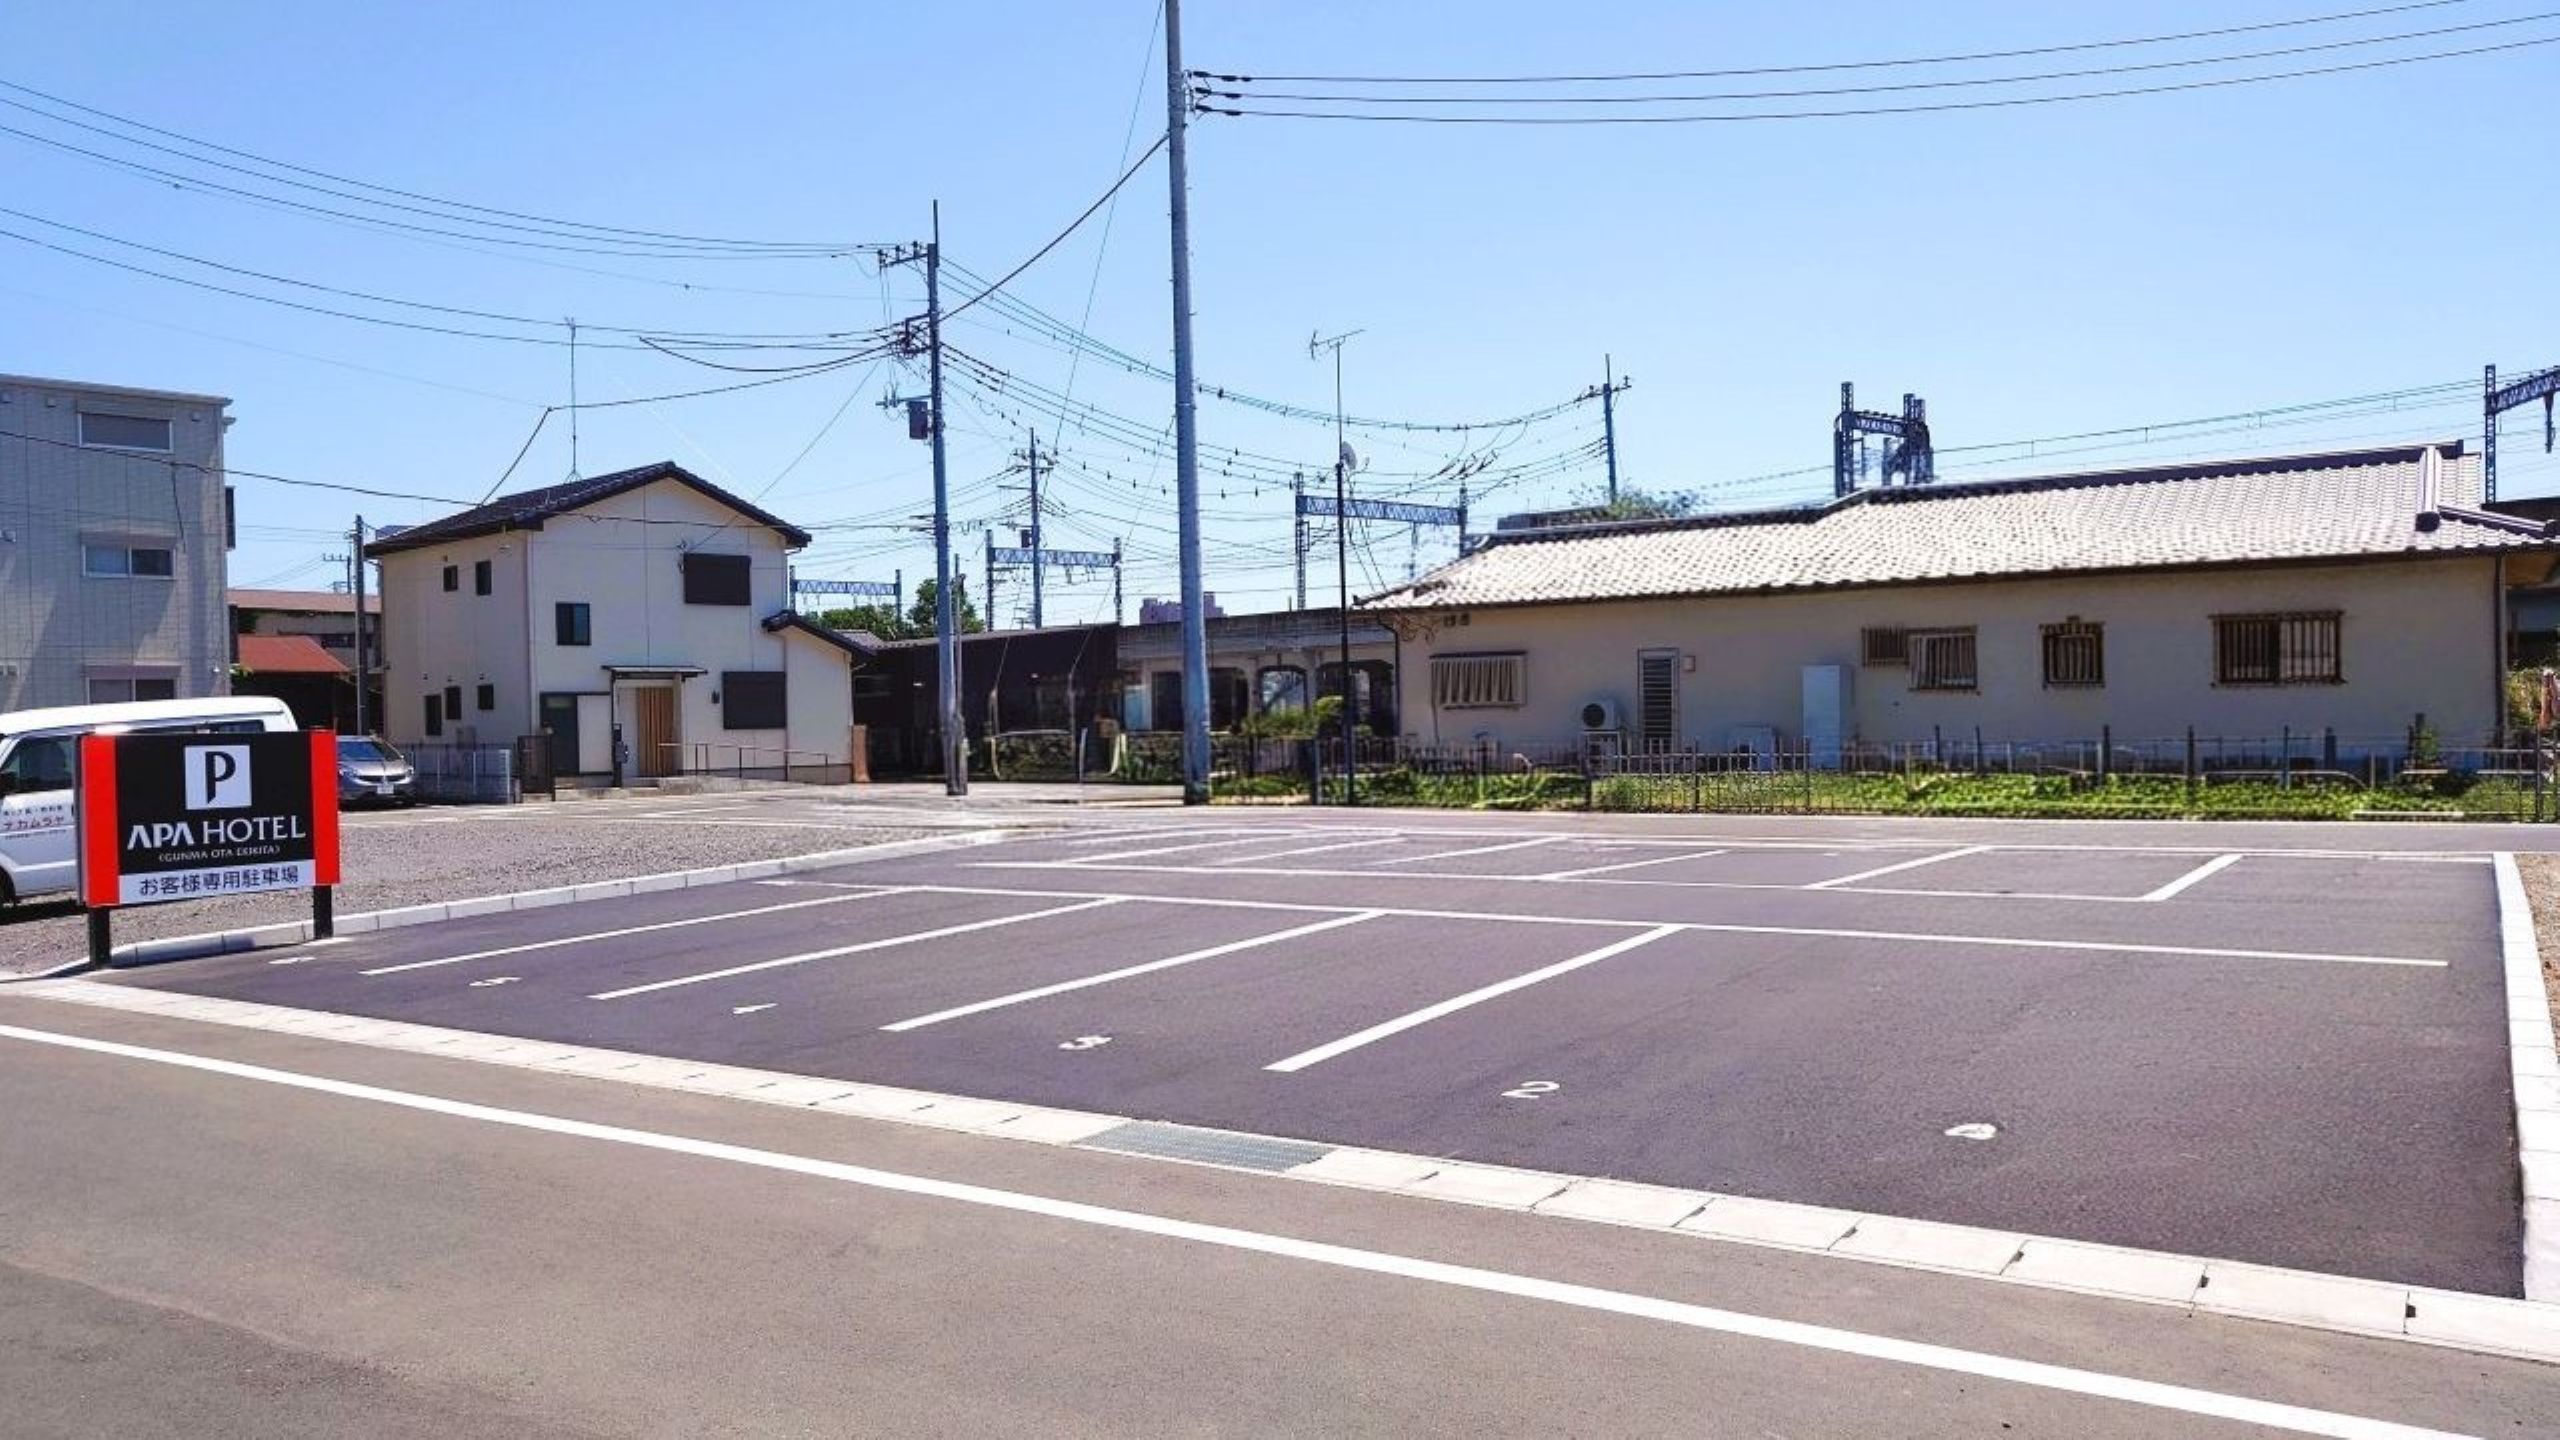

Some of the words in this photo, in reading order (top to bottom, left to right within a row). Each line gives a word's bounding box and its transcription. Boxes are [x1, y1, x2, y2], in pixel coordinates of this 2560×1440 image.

[205, 751, 236, 804] P
[127, 820, 195, 850] APA
[203, 815, 306, 845] HOTEL
[211, 848, 233, 859] OTA
[139, 864, 299, 897] お客様専用駐車場
[1501, 1080, 1560, 1099] 2
